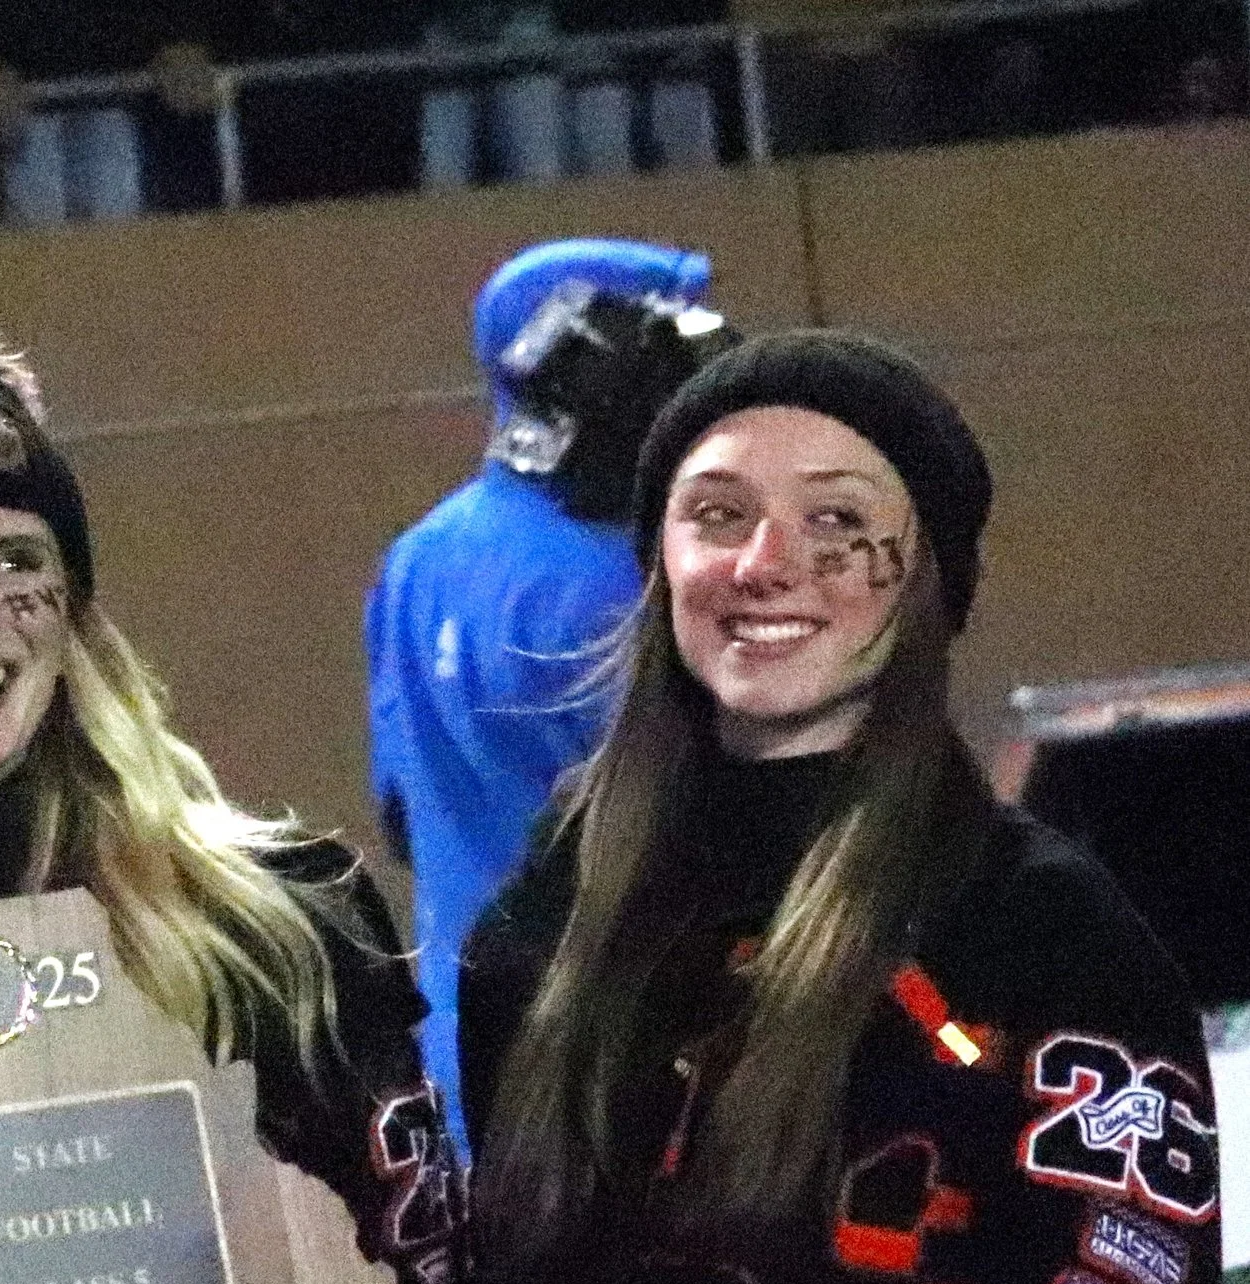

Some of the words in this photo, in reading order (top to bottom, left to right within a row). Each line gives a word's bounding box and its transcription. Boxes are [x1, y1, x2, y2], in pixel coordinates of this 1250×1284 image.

[37, 951, 100, 1008] 25
[12, 1133, 114, 1172] STATE
[1026, 1034, 1218, 1217] 26
